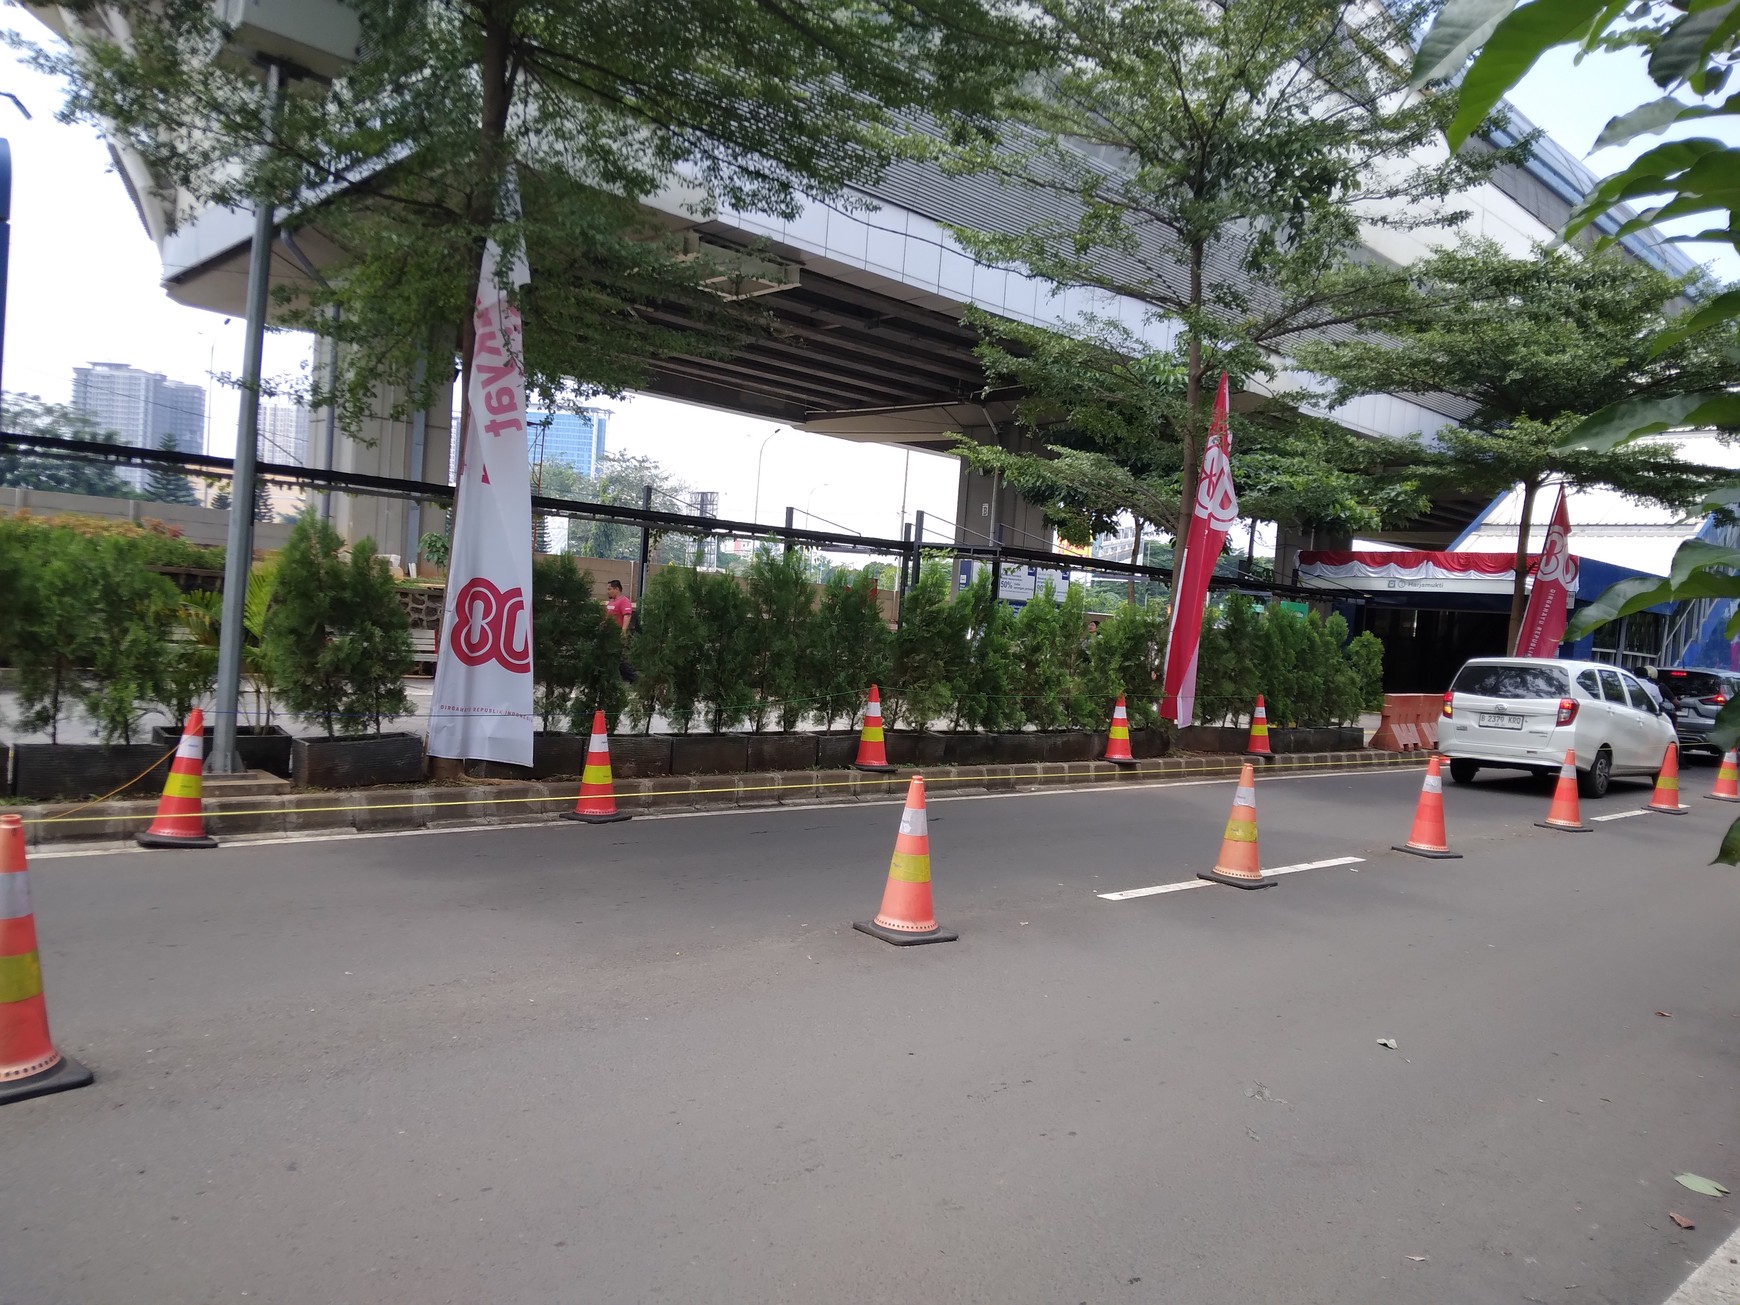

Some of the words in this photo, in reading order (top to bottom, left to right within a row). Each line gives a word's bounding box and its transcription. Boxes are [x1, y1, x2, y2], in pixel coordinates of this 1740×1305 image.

[451, 577, 532, 674] 80
[1480, 714, 1486, 722] B
[1487, 715, 1505, 723] 2379
